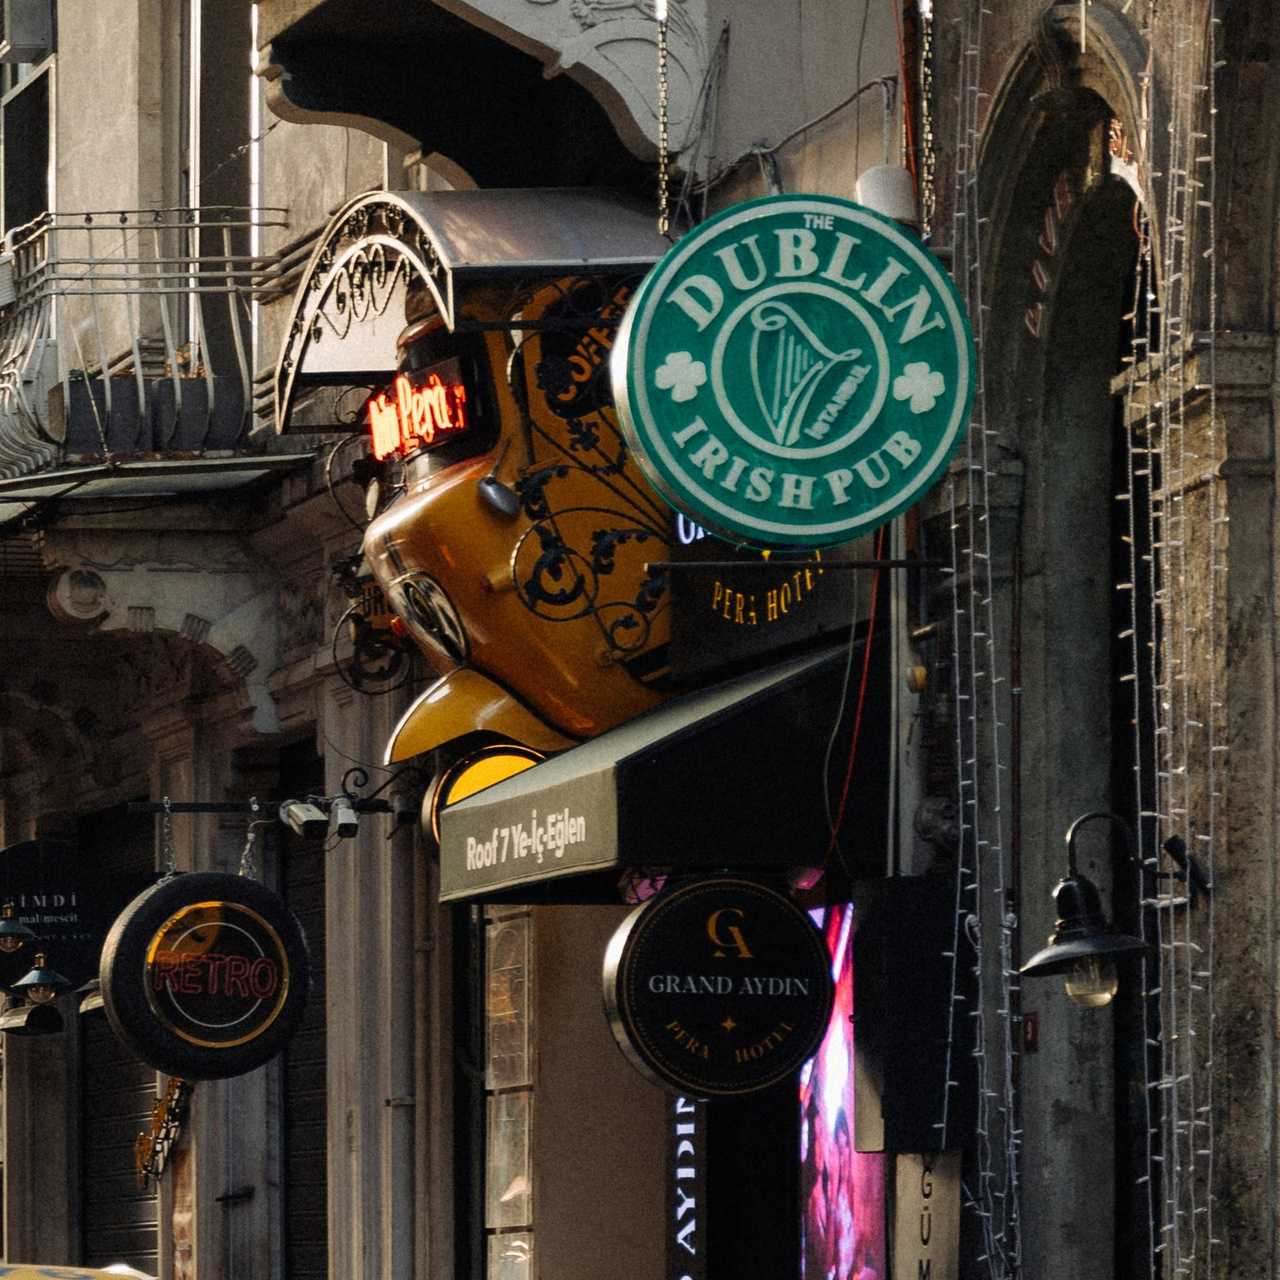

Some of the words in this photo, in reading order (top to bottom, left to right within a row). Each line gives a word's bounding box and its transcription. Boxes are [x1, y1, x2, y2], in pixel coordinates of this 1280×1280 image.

[803, 214, 834, 230] THE
[666, 228, 946, 344] DUBLIN
[672, 415, 817, 510] IRISH
[824, 431, 922, 505] PUB
[466, 827, 499, 871] Roof
[500, 828, 510, 863] 7
[9, 892, 77, 908] İMDİ
[154, 950, 279, 999] RETRO
[648, 974, 733, 995] GRAND
[738, 976, 810, 996] AYDIN
